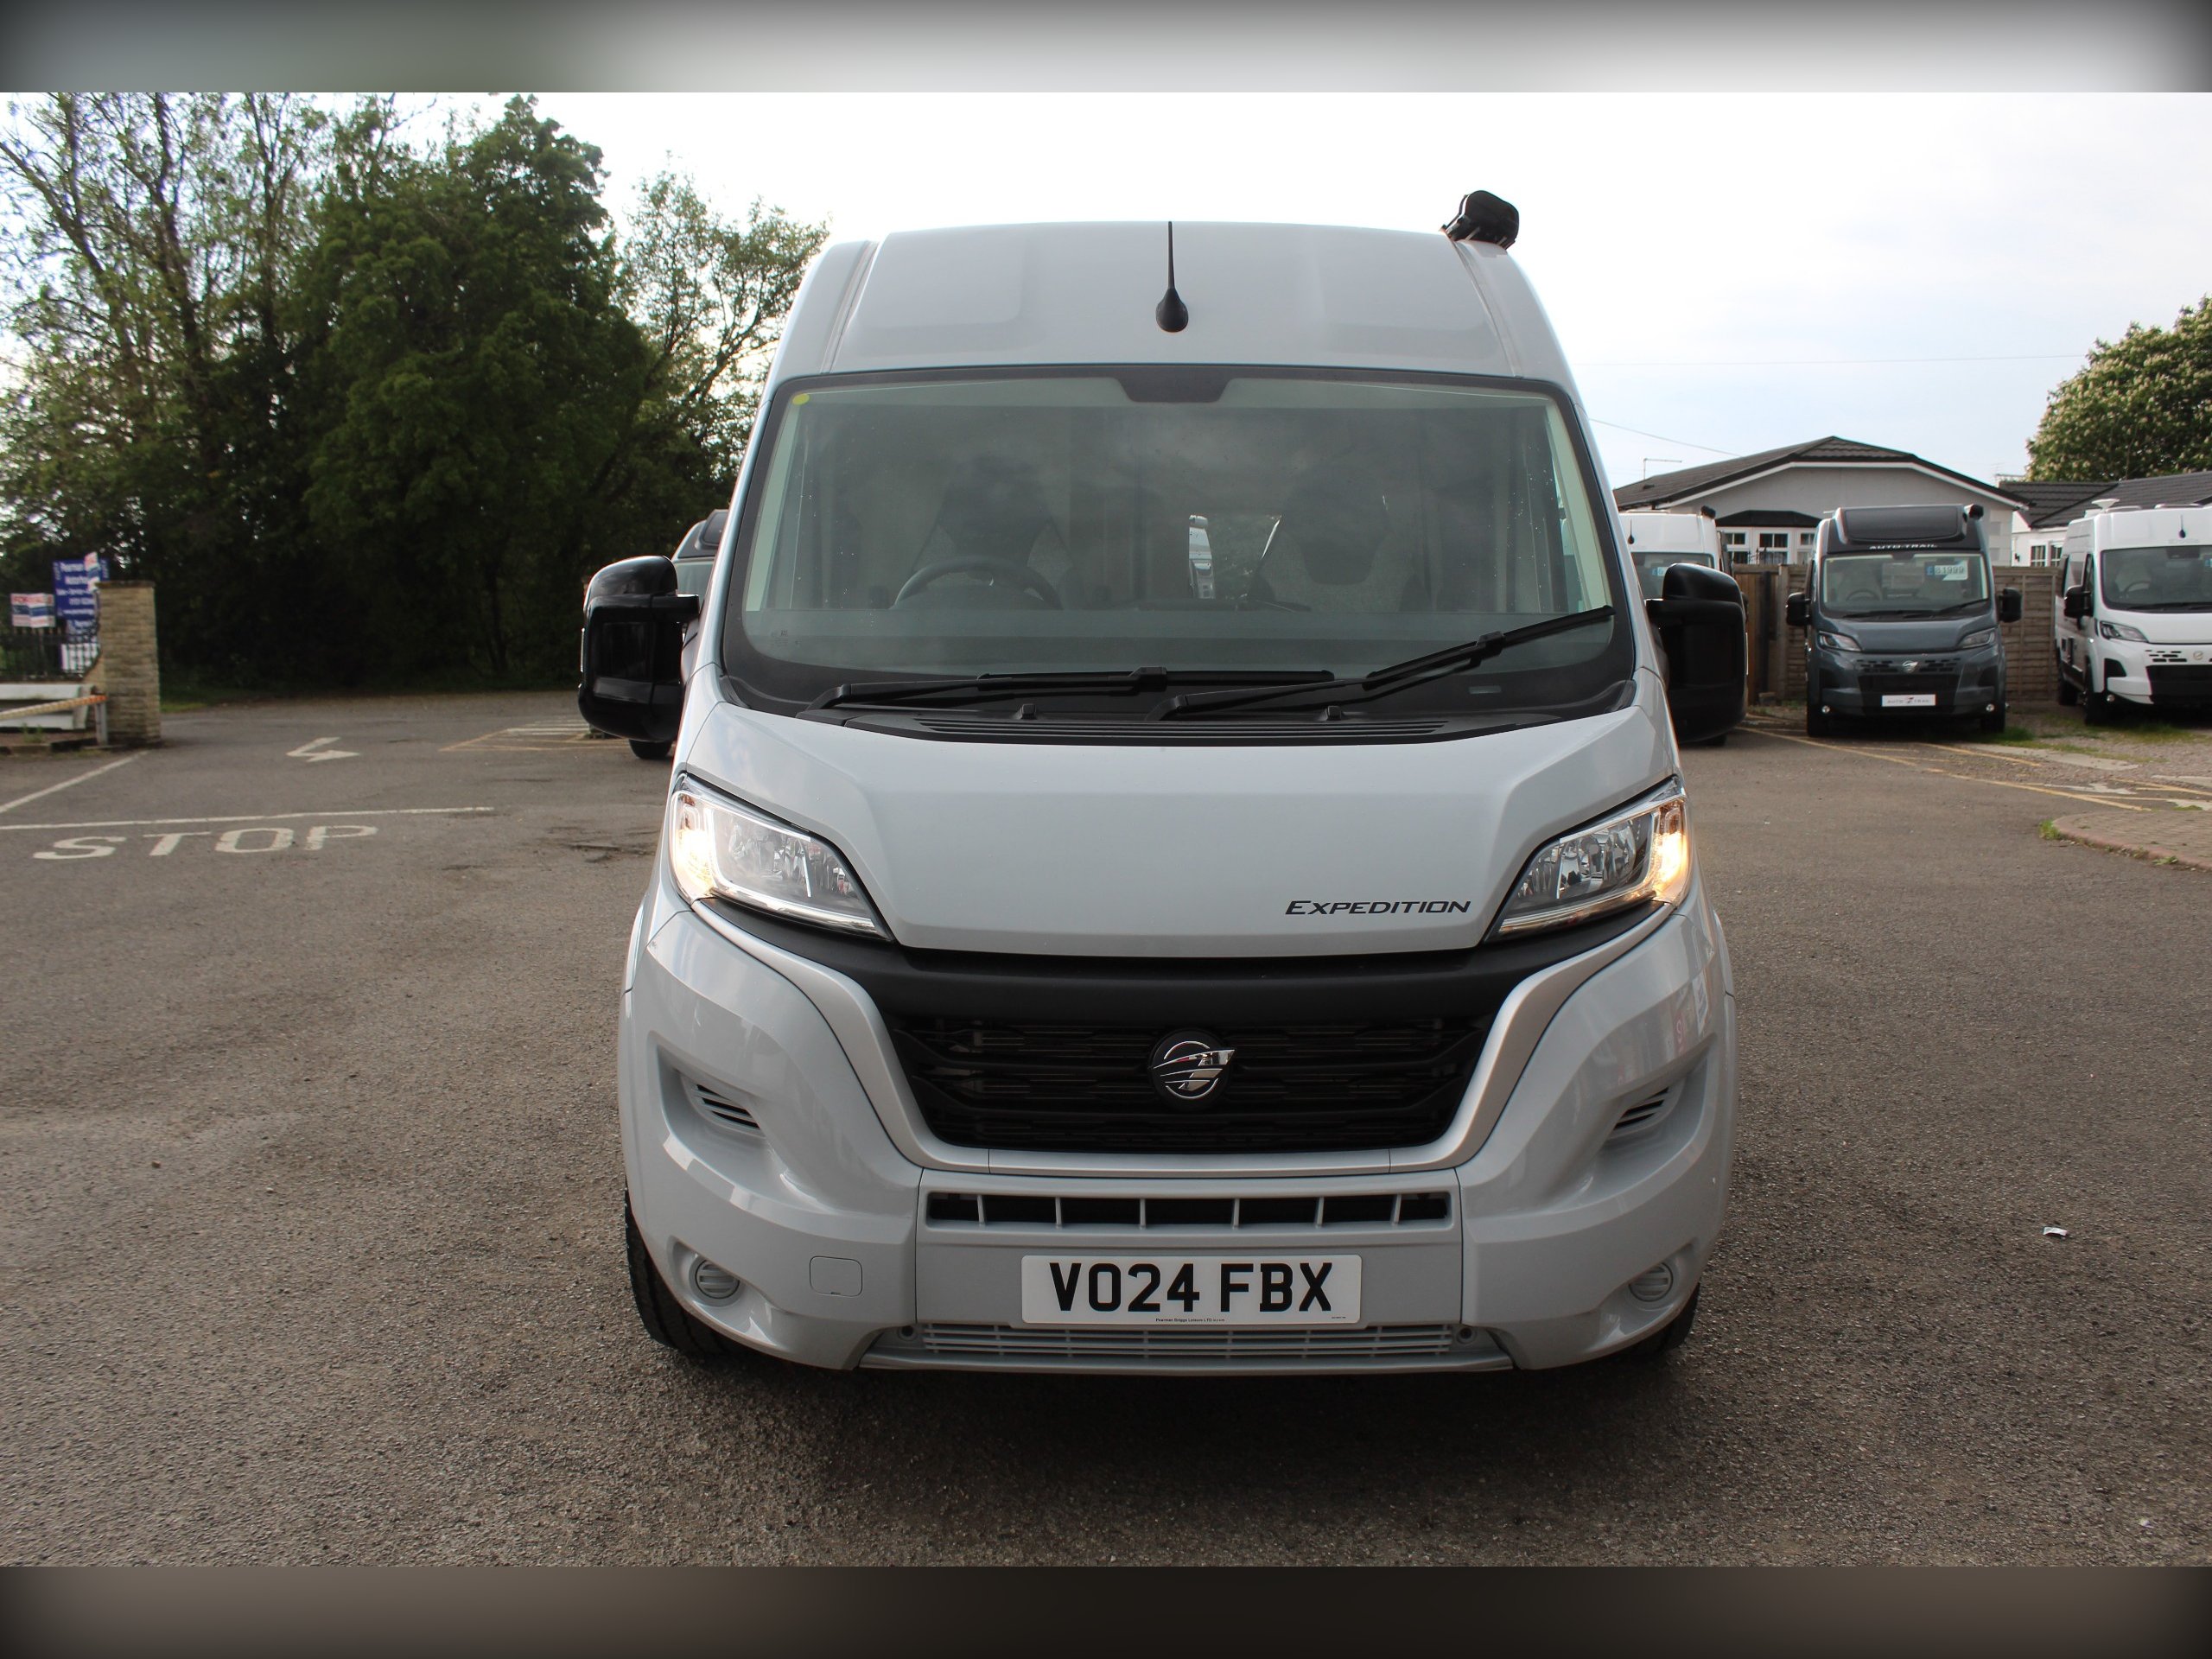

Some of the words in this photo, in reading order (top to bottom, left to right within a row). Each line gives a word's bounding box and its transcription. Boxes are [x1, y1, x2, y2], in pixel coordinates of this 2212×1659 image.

[33, 825, 378, 860] STOP
[1049, 1262, 1200, 1313] VO24
[1220, 1262, 1332, 1313] FBX
